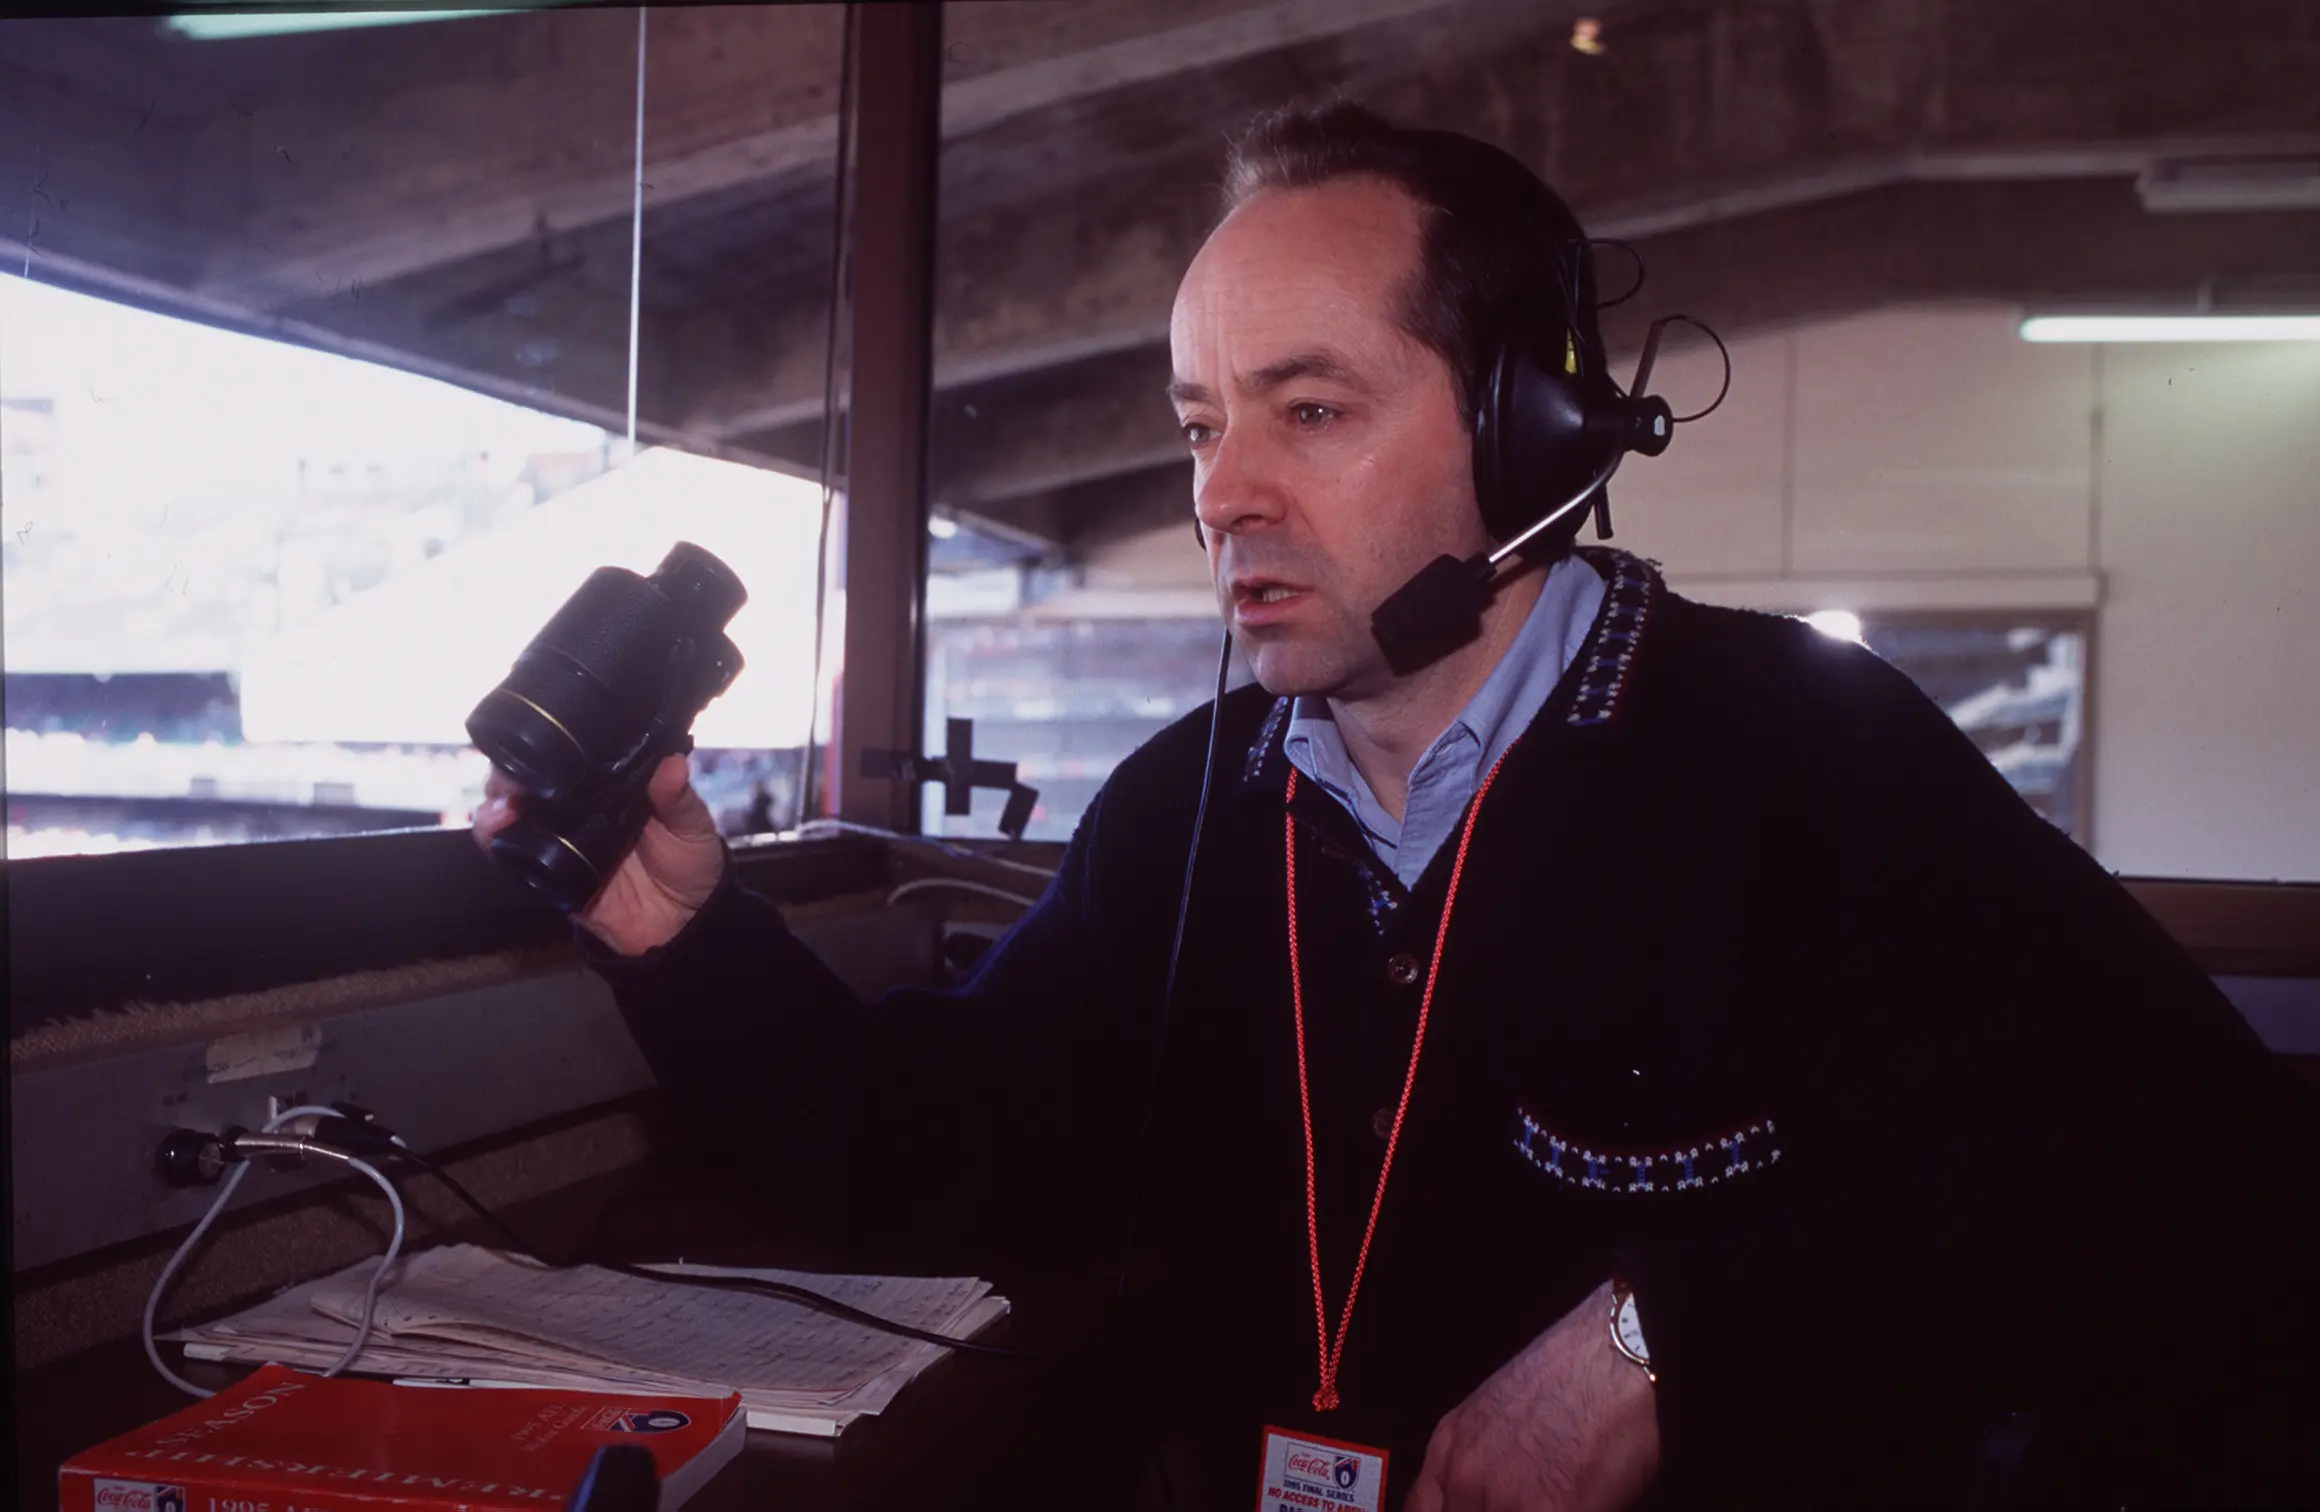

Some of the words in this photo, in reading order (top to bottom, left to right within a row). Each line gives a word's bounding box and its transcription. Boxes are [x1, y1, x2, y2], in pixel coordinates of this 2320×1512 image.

[156, 1381, 306, 1444] SEASON
[1268, 1486, 1282, 1498] NO
[1283, 1490, 1320, 1508] ACCESS
[1322, 1499, 1335, 1511] TO
[1302, 1484, 1323, 1497] FINAL
[1326, 1490, 1355, 1503] SERIES
